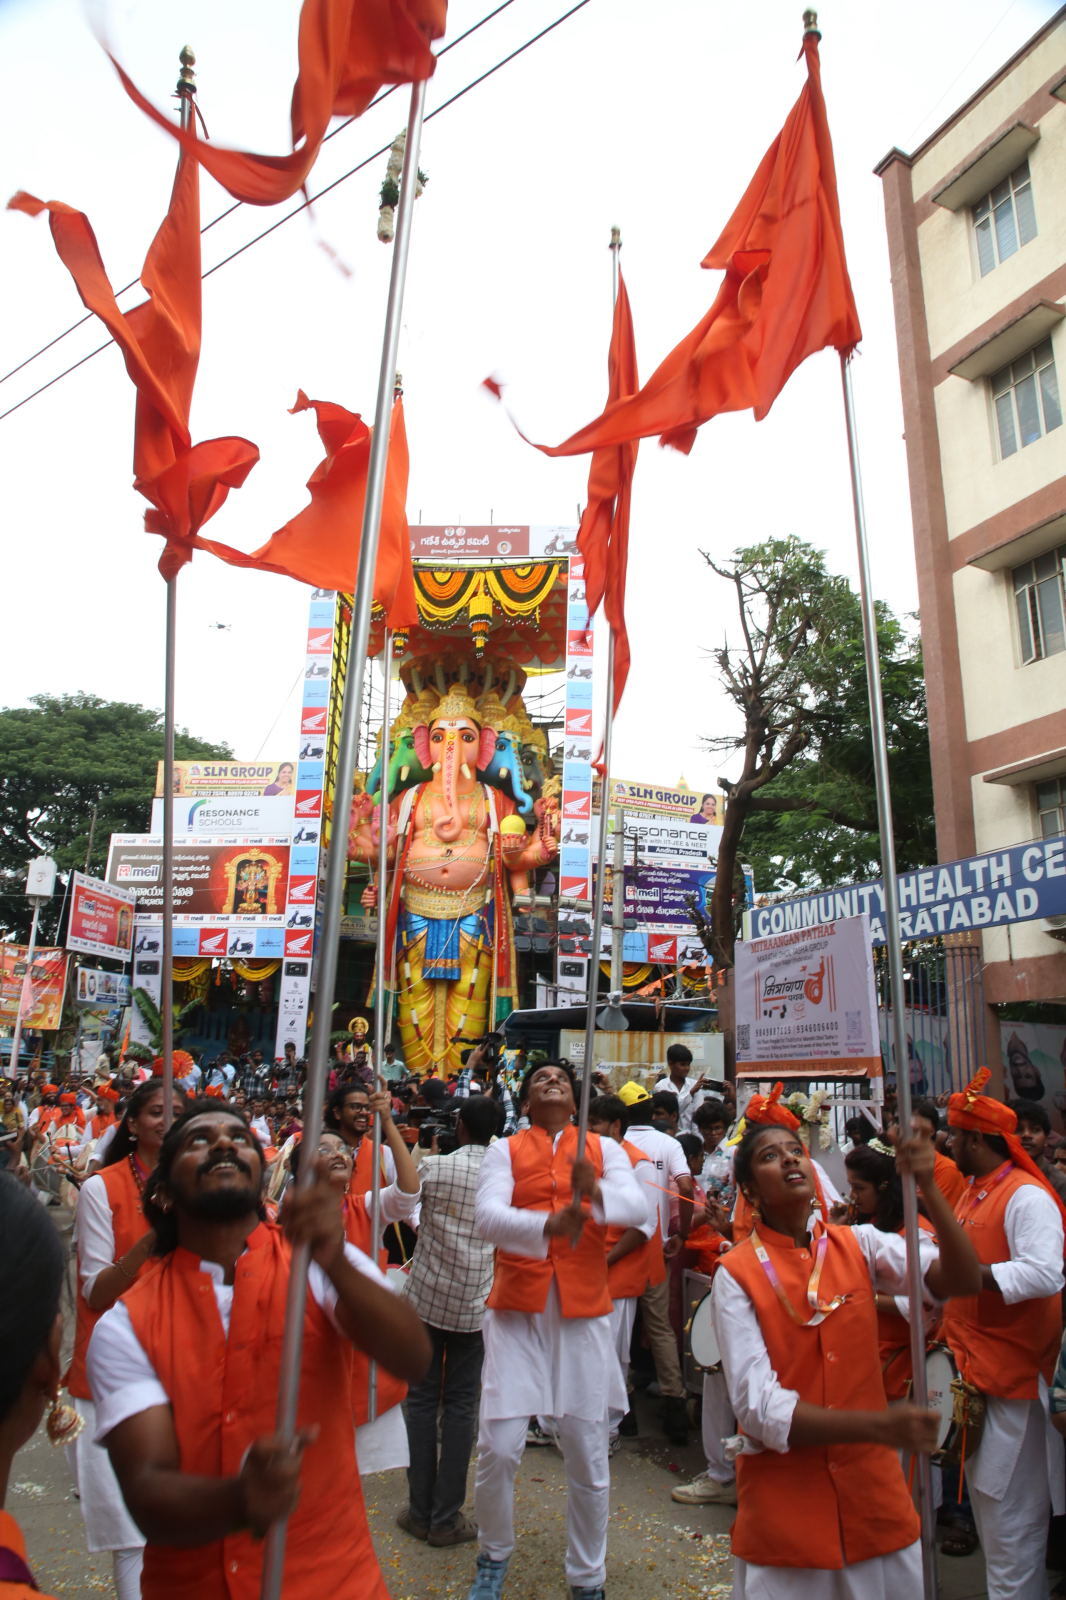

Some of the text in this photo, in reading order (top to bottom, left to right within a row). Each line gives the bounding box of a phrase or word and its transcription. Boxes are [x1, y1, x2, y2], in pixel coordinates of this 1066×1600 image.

[204, 766, 273, 777] SLN GROUP
[629, 786, 697, 806] SLN GROUP
[199, 809, 260, 817] RESONANCE
[199, 818, 242, 826] SCHOOLS
[132, 865, 158, 877] meil
[638, 887, 659, 897] meil
[757, 883, 886, 937] COMMUNITY
[899, 853, 1013, 908] HEALTH
[801, 922, 836, 942] PATHAK
